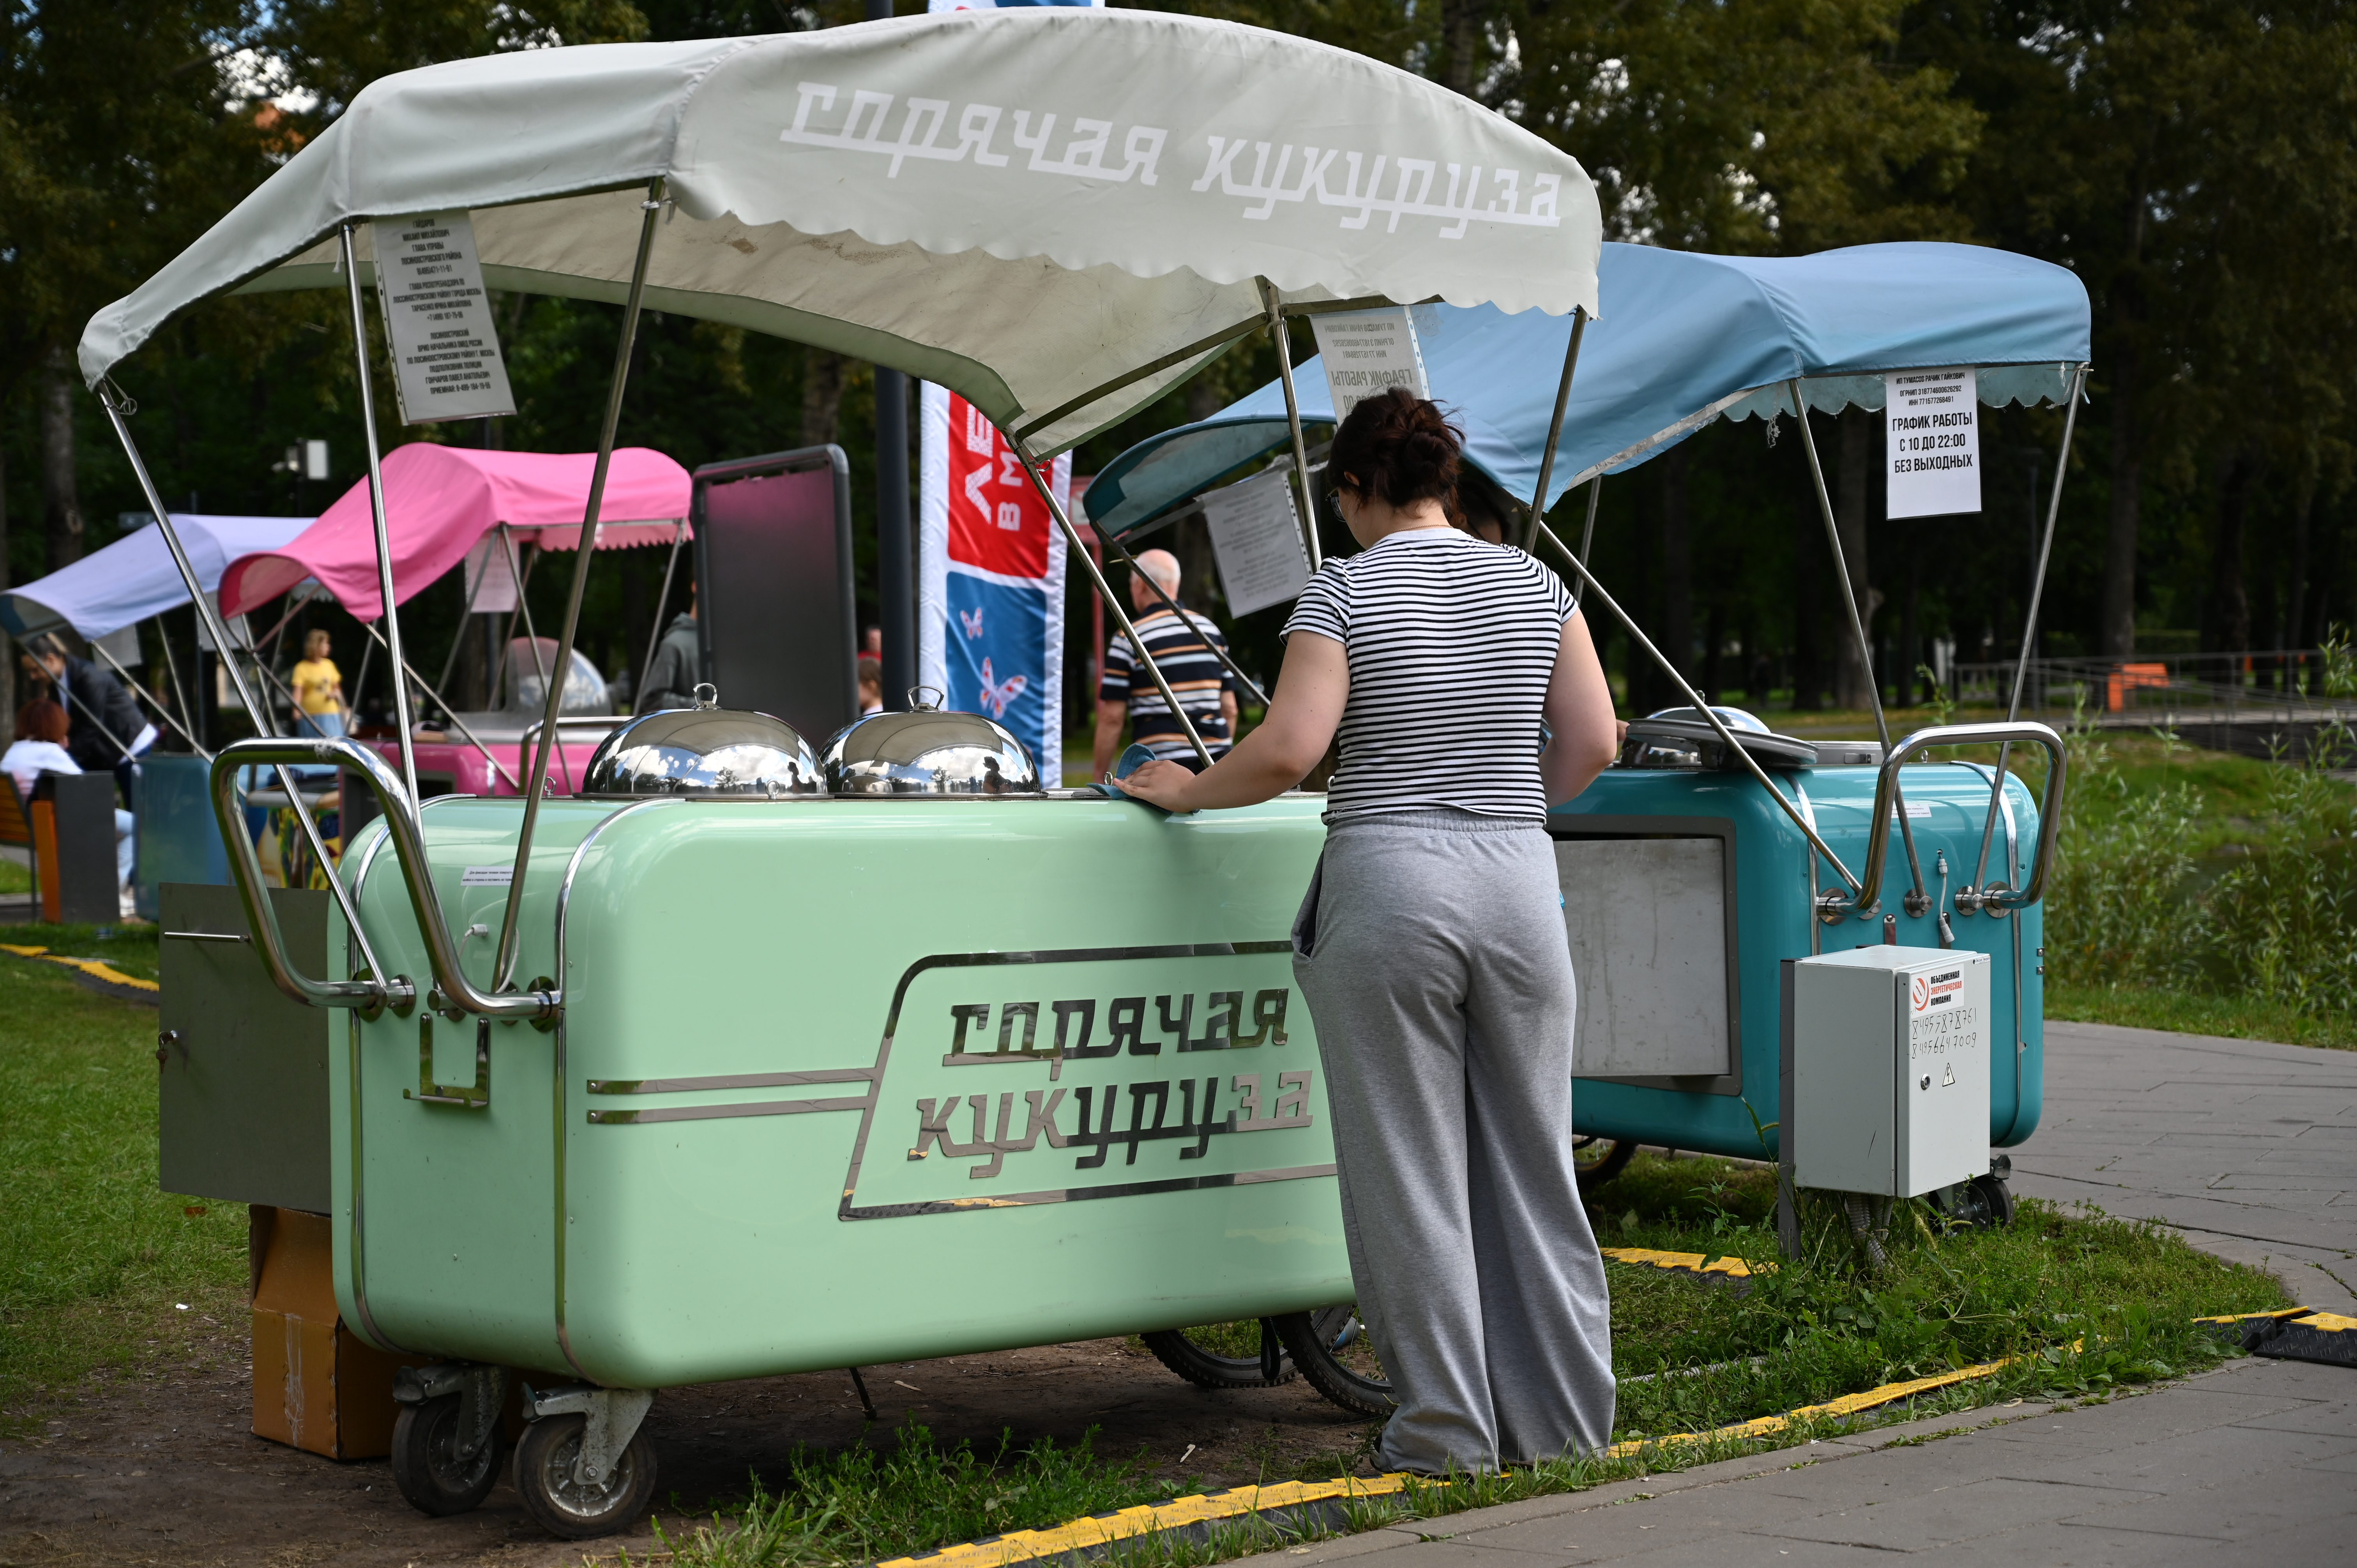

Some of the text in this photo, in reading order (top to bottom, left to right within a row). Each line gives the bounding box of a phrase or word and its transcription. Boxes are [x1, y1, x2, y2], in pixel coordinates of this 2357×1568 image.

[780, 81, 1562, 239] горячая кукуруза
[412, 242, 444, 252] ГЛАВА УПРАВЫ
[445, 251, 462, 260] РАЙОНА
[1941, 372, 1965, 381] ГАЙКОВИЧ
[1900, 385, 1962, 397] ОГРНИП 318774600626292
[1919, 396, 1954, 405] 771577268491
[1892, 412, 1972, 431] ГРАФИК РАБОТЫ
[1900, 433, 1966, 451] С 10 ДО 22:00
[1894, 454, 1973, 473] БЕЗ ВЫХОДНЫХ
[1931, 970, 1960, 984] ОБЪЕДИНЕННАЯ
[1931, 980, 1962, 995] ЭНЕРГЕТИЧЕСКАЯ
[1931, 994, 1951, 1006] КОМПАНИЯ
[942, 988, 1289, 1081] горячая
[908, 1070, 1313, 1179] кукуруза
